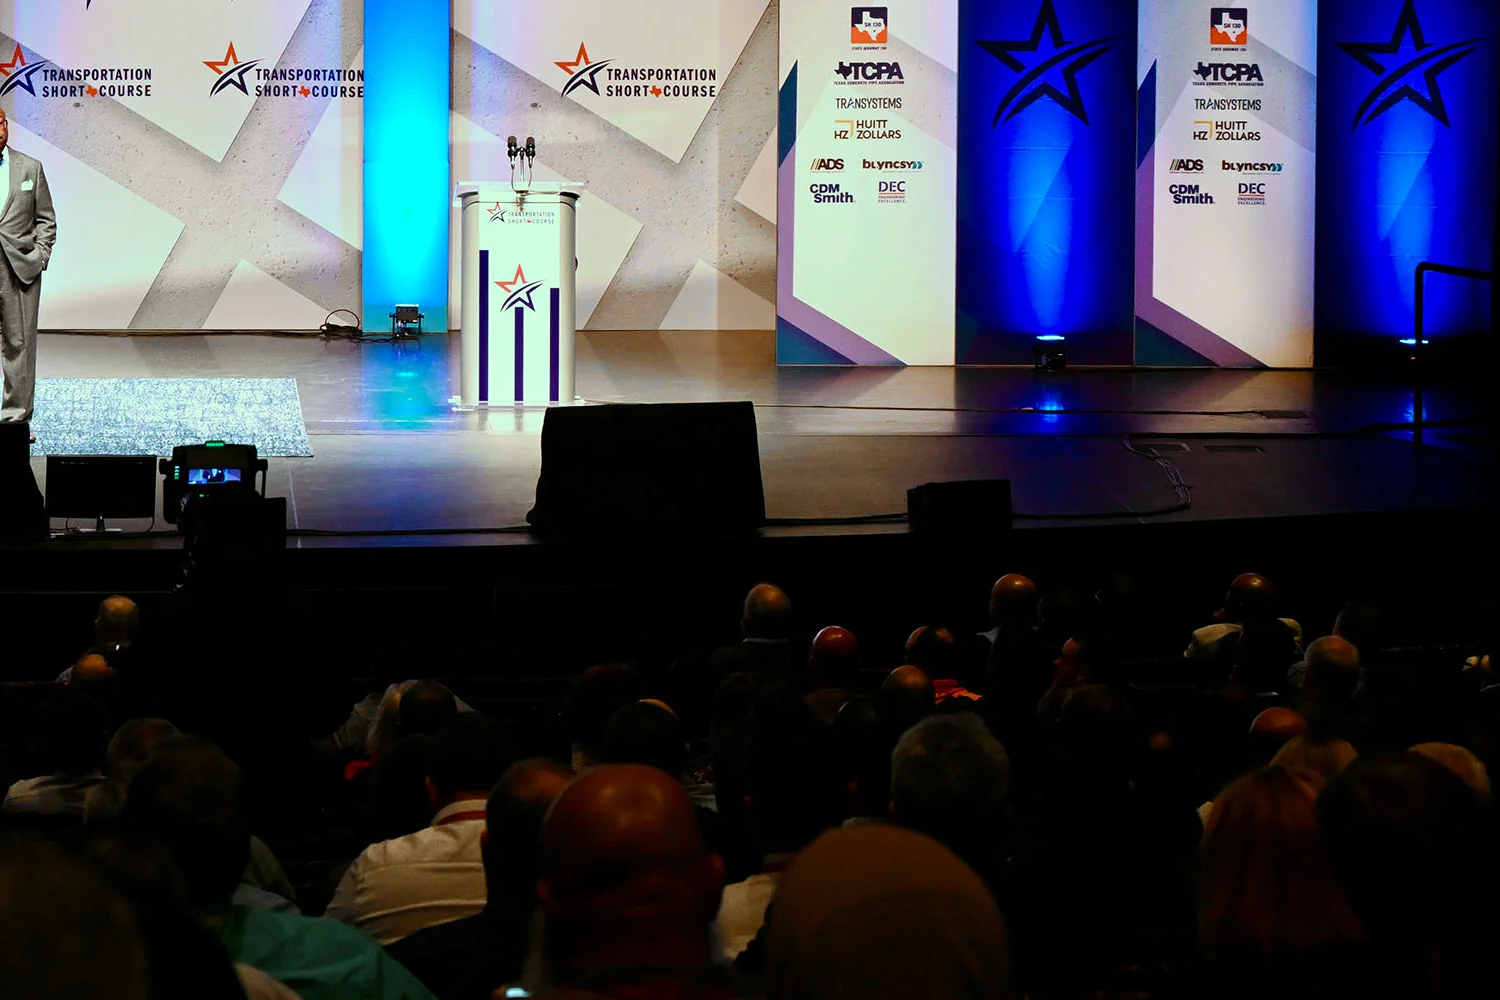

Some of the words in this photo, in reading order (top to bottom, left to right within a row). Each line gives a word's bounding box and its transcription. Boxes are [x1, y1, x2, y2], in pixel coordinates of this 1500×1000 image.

[42, 68, 152, 81] TRANSPORTATION
[255, 68, 364, 82] TRANSPORTATION
[606, 68, 717, 81] TRANSPORTATION
[851, 62, 904, 80] TCPA
[1209, 63, 1264, 81] TCPA
[42, 85, 84, 98] SHORT
[99, 85, 151, 97] COURSE
[255, 85, 297, 97] SHORT
[311, 85, 364, 98] COURSE
[606, 85, 649, 98] SHORT
[663, 85, 716, 98] COURSE
[836, 97, 902, 109] TRANSYSTEMS
[1194, 98, 1261, 111] TRANSYSTEMS
[856, 120, 888, 129] HUITT
[1215, 121, 1247, 130] HUITT
[834, 130, 849, 139] HZ
[857, 130, 901, 139] ZOLLARS
[1193, 131, 1208, 141] HZ
[1215, 131, 1261, 141] ZOLLARS
[809, 183, 840, 193] CDM
[878, 181, 906, 192] DEC
[1169, 184, 1199, 194] CDM
[1238, 183, 1266, 194] DEC
[813, 191, 854, 204] Smith
[1173, 192, 1213, 205] Smith
